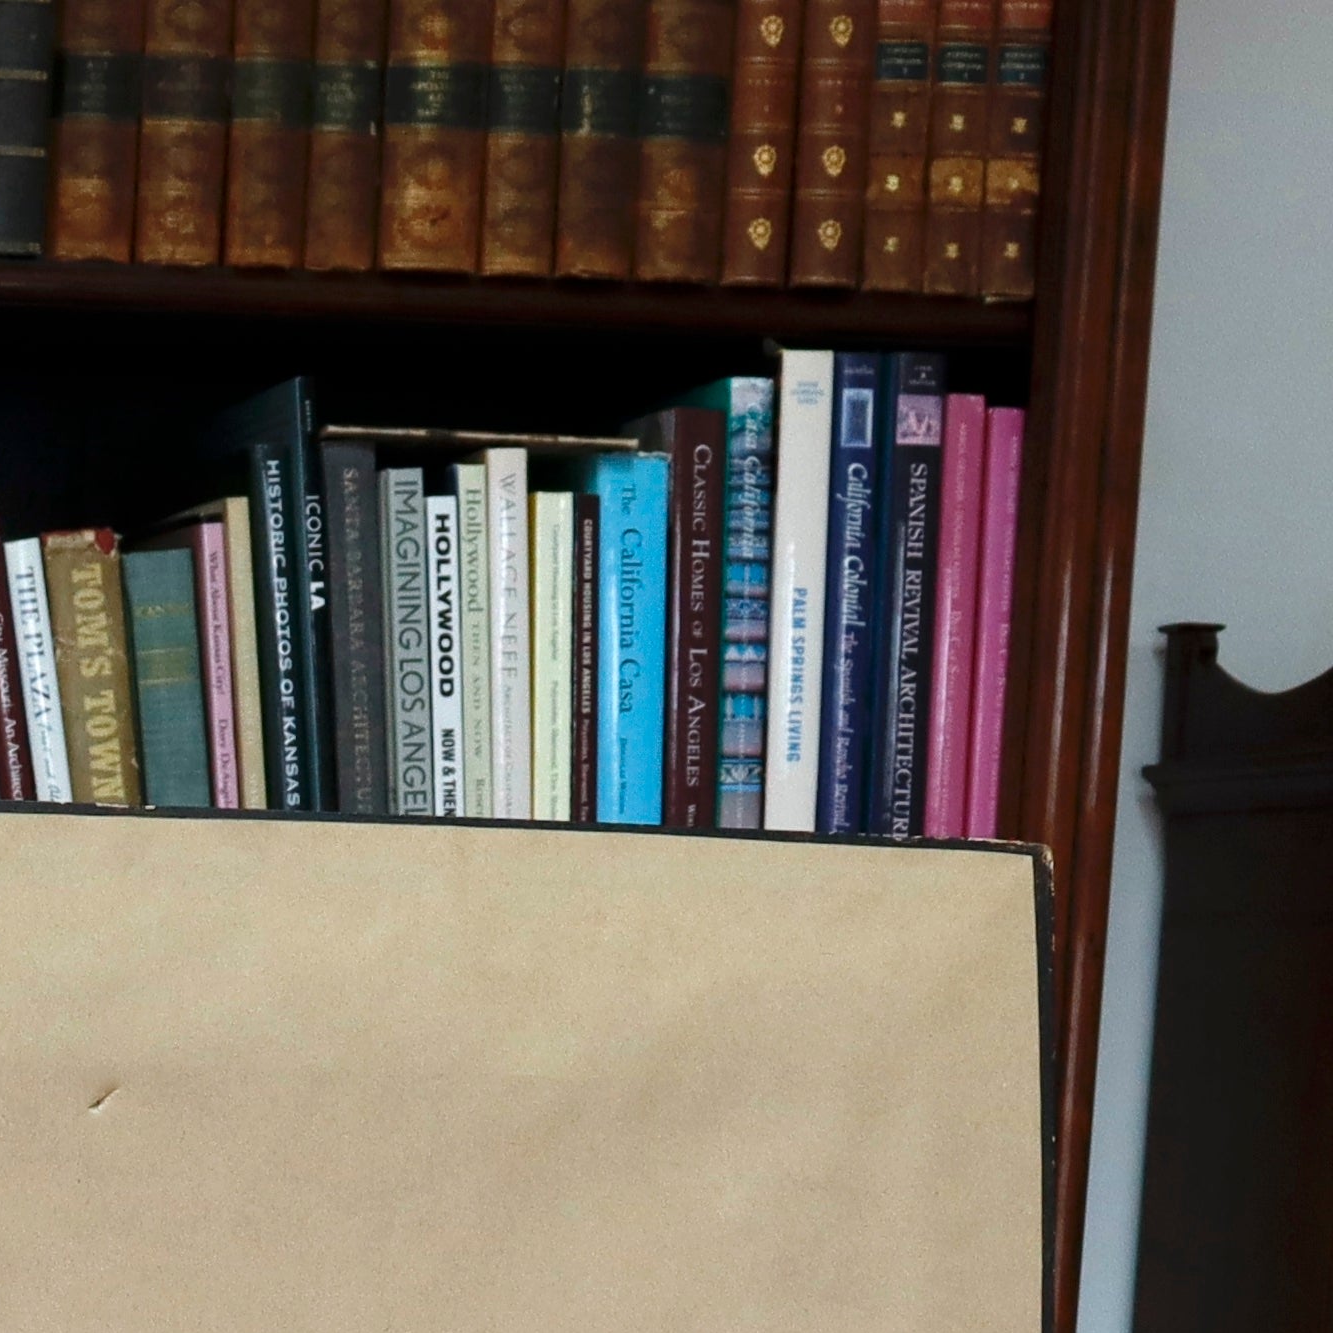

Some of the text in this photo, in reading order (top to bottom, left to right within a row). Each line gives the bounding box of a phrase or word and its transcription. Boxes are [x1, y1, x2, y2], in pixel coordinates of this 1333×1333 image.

[305, 495, 325, 611] ICONIC LA
[343, 467, 364, 650] SANTA BARBARA
[501, 474, 519, 679] WALLACE NEFF
[741, 455, 765, 558] California
[837, 463, 871, 548] California
[842, 555, 869, 626] Colonial
[906, 463, 928, 559] SPANISH
[16, 566, 52, 719] THE PLAZA
[71, 562, 126, 801] TOM'S TOWN
[266, 460, 301, 806] HISTORIC PHOTOS OF KANSAS
[394, 480, 428, 713] IMAGINING LOS
[436, 514, 457, 816] HOLLYWOOD NOW & THEN
[463, 488, 485, 758] Hollywood THEN AND NOW
[580, 519, 592, 713] COURTYARD HOUSING IN LOS ANGELES
[619, 485, 644, 715] The California Casa
[686, 444, 712, 786] CLASSIC HOMES OF LOS ANGELES
[786, 587, 809, 762] PALM SPRINGS LIVING
[837, 660, 855, 705] Spanish
[900, 569, 924, 660] REVIVAL
[4, 719, 18, 737] An
[839, 711, 854, 731] and
